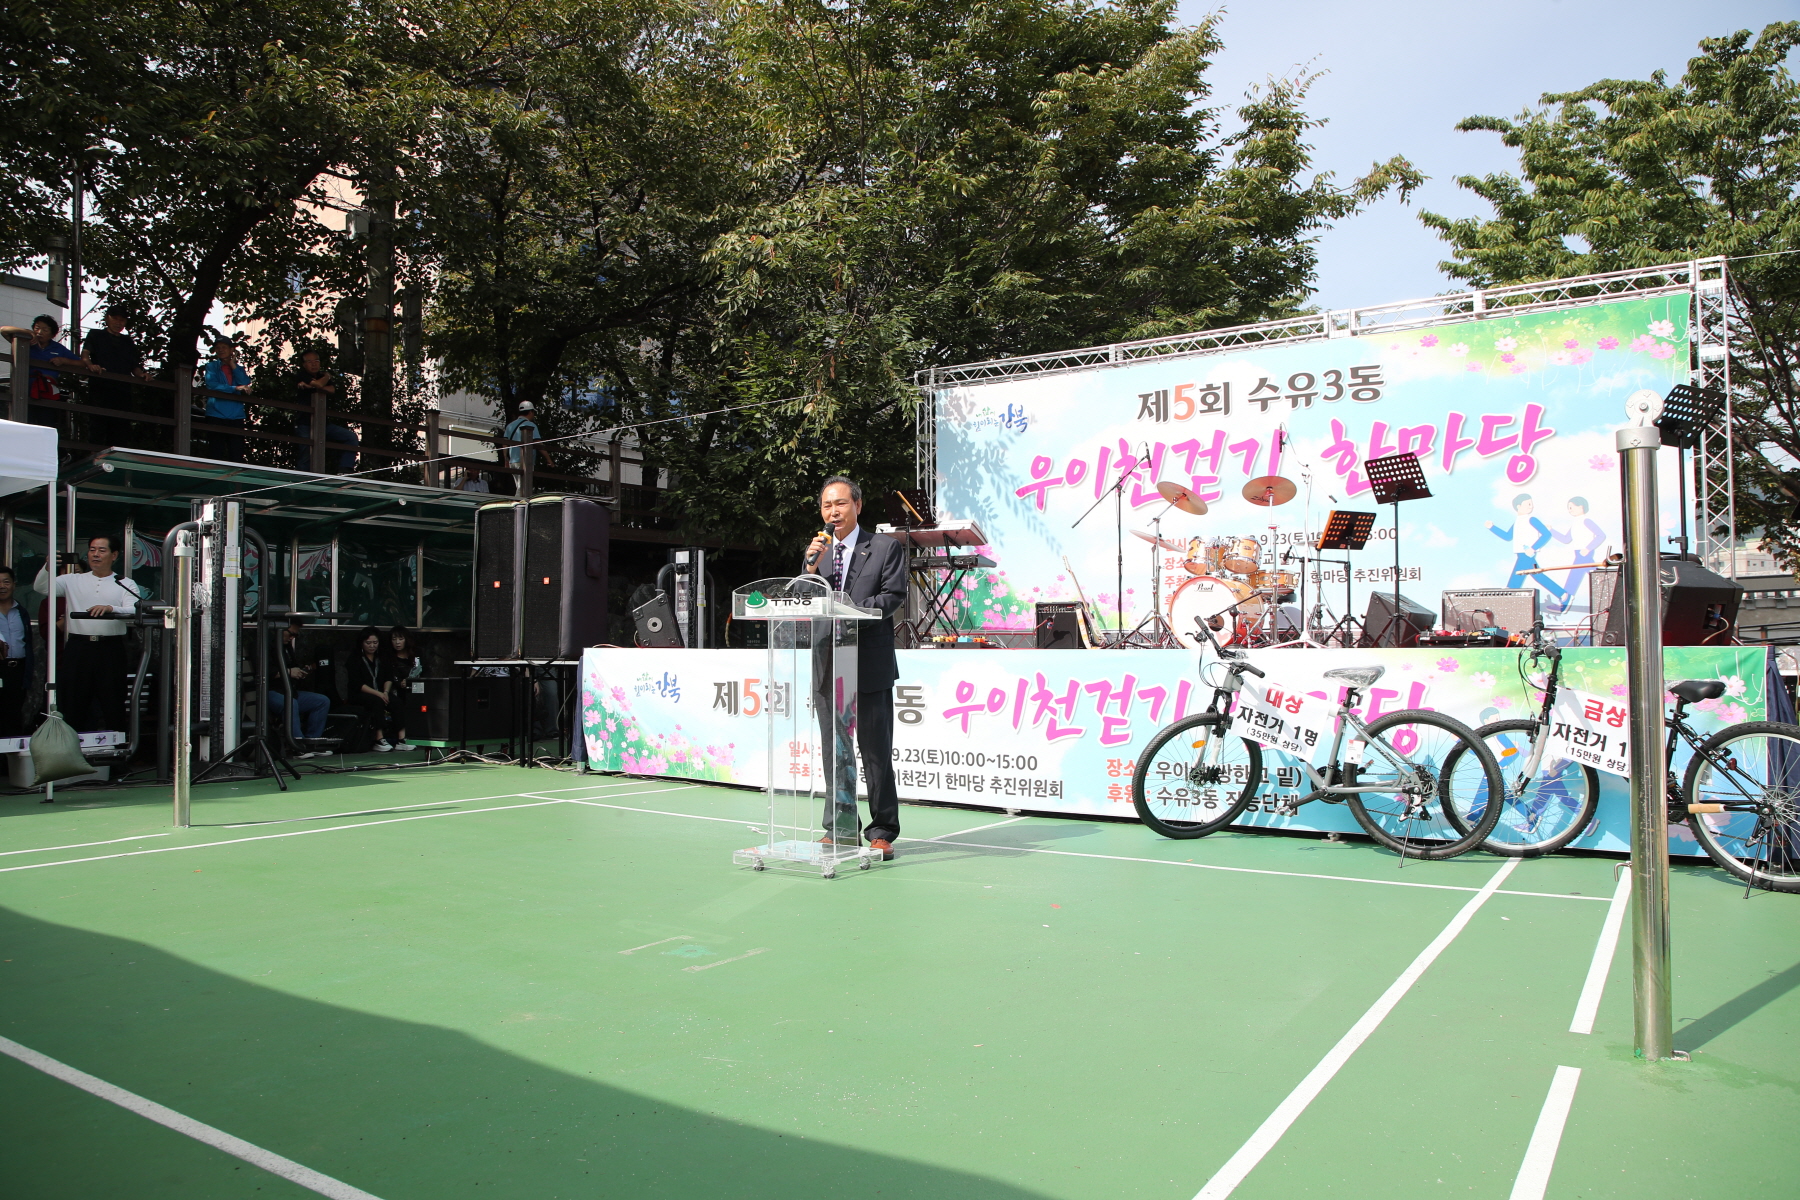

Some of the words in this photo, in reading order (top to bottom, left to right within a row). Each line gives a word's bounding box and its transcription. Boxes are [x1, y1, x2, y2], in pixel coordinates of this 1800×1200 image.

[1137, 382, 1230, 423] 제5회
[1247, 364, 1386, 412] 수유3동
[998, 402, 1029, 434] 강북
[1014, 428, 1287, 513] 우이천걷기
[1319, 403, 1555, 497] 한마당
[1353, 566, 1421, 583] 추진위원회
[655, 671, 681, 703] 강북
[1265, 687, 1304, 714] 대상
[712, 678, 791, 718] 제5회
[942, 671, 1192, 745] 우이천걷기
[1584, 698, 1627, 728] 금상
[1236, 705, 1285, 735] 자전거
[1293, 725, 1319, 747] 1명
[1246, 727, 1279, 745] (35만원
[1282, 739, 1303, 753] 상당)
[1552, 722, 1607, 752] 자전거
[1565, 745, 1602, 765] (15만원
[945, 772, 985, 793] 한마당
[989, 776, 1063, 799] 추진위원회
[1156, 786, 1219, 809] 수유3동
